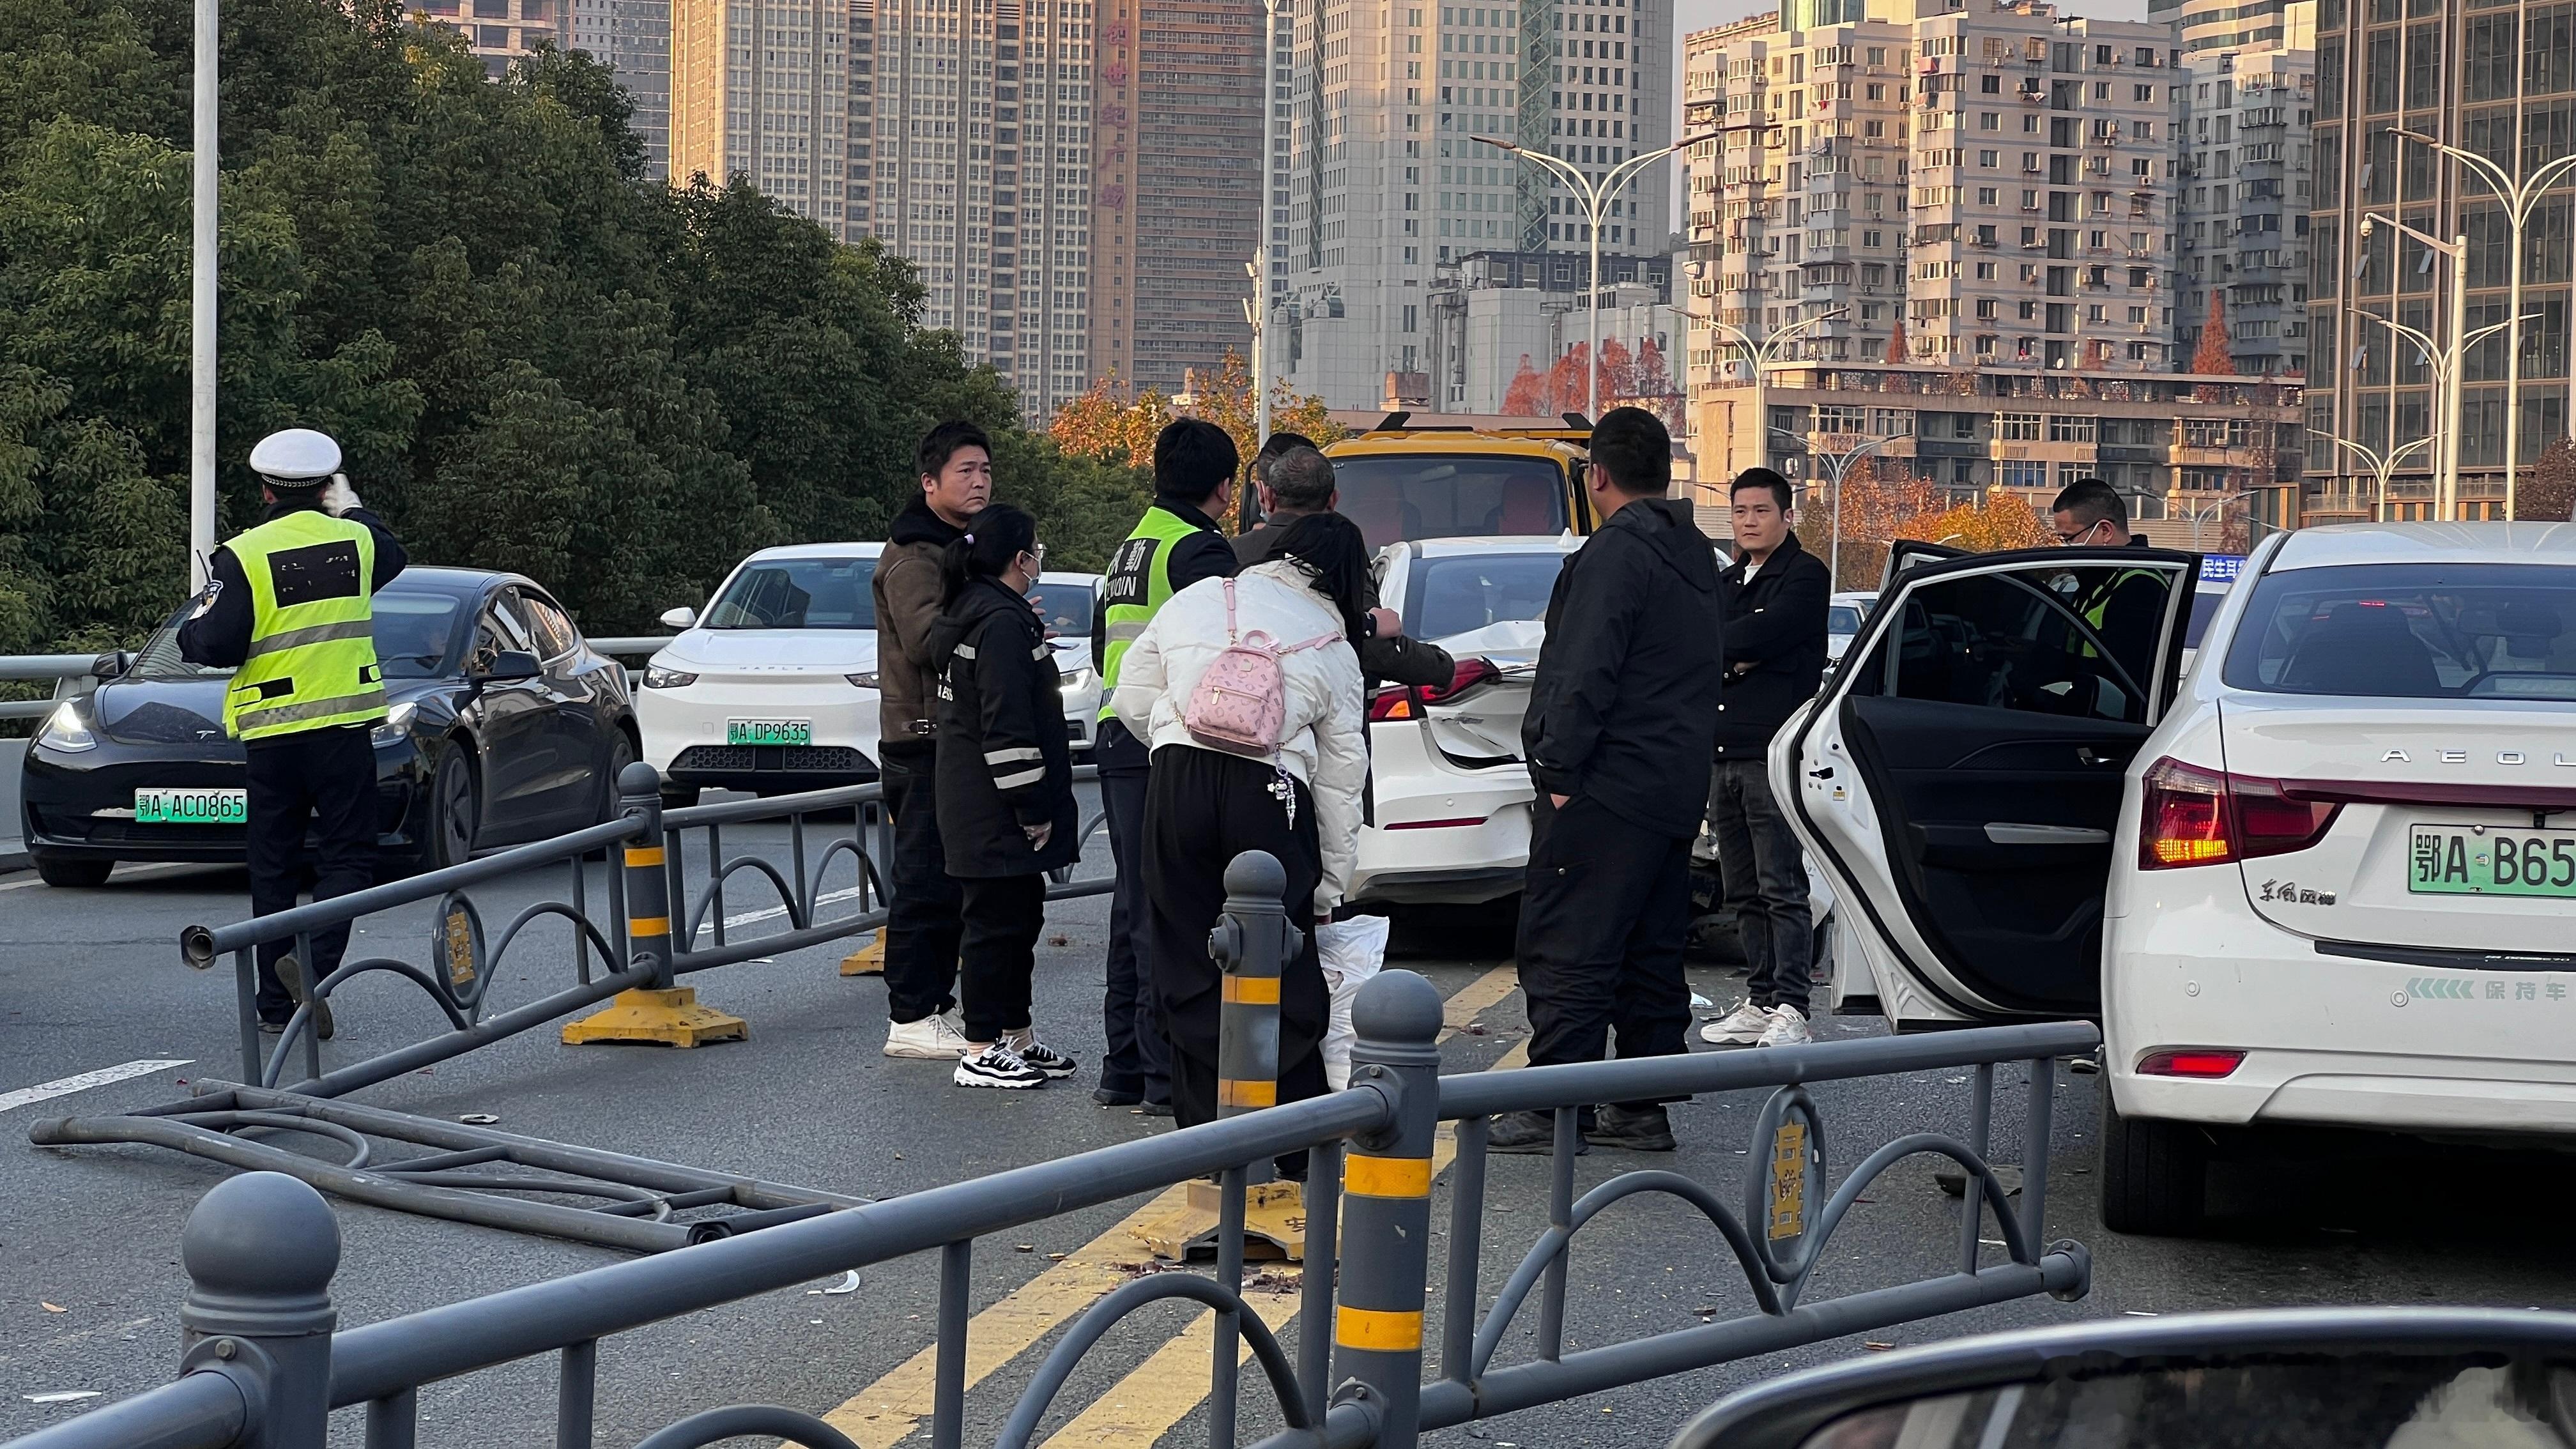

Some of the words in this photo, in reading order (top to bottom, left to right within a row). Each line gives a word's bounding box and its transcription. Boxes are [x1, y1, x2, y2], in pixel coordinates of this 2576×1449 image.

[2380, 748, 2576, 767] AEOL
[2485, 980, 2567, 1001] 保持车
